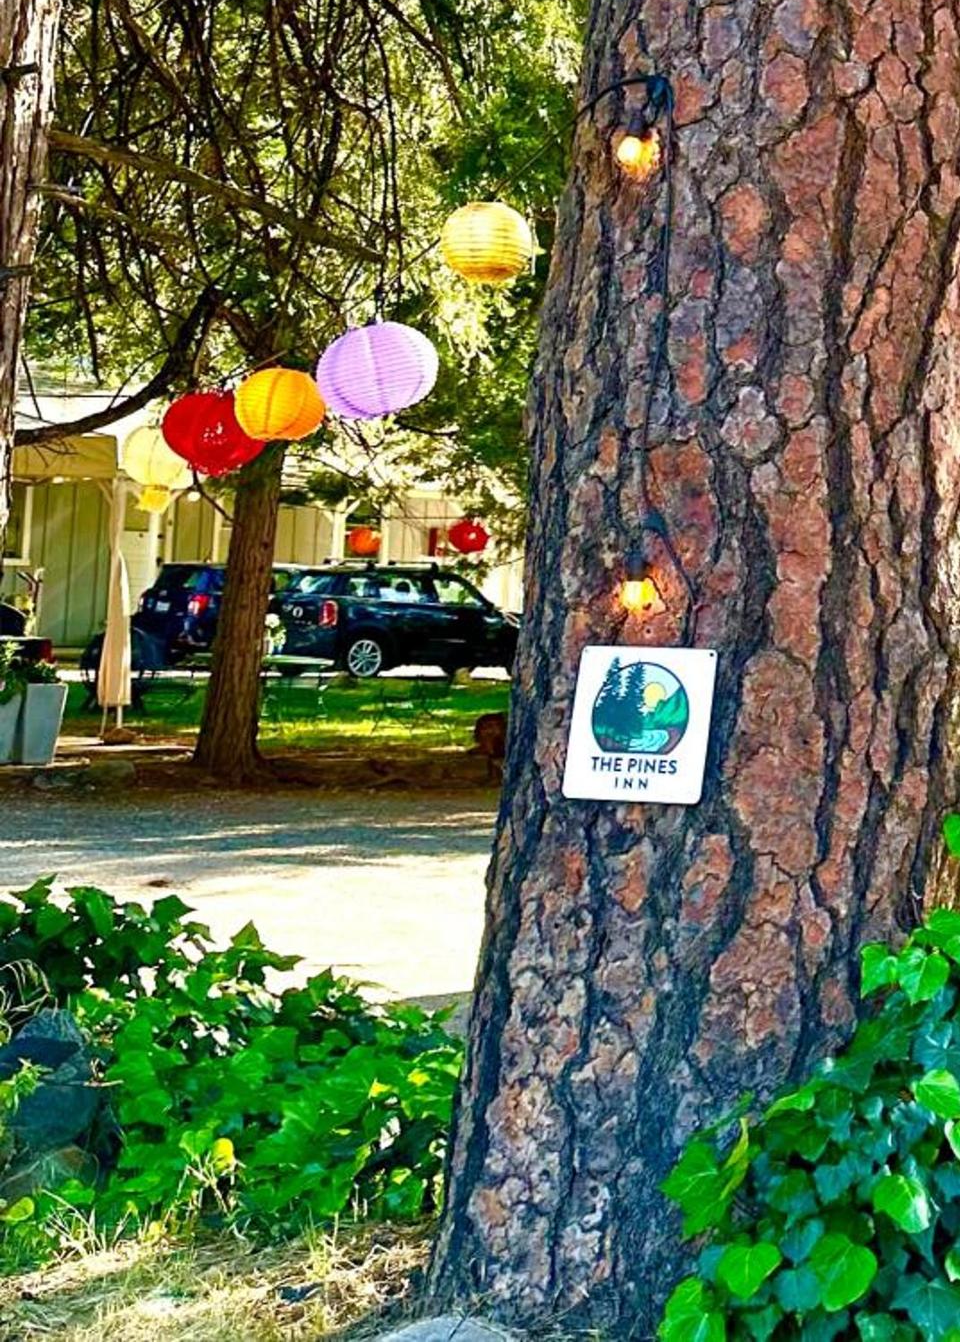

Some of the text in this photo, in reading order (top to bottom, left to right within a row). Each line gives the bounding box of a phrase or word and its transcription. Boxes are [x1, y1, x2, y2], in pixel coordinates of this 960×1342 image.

[591, 756, 677, 774] THE PINES
[614, 777, 649, 789] INN
